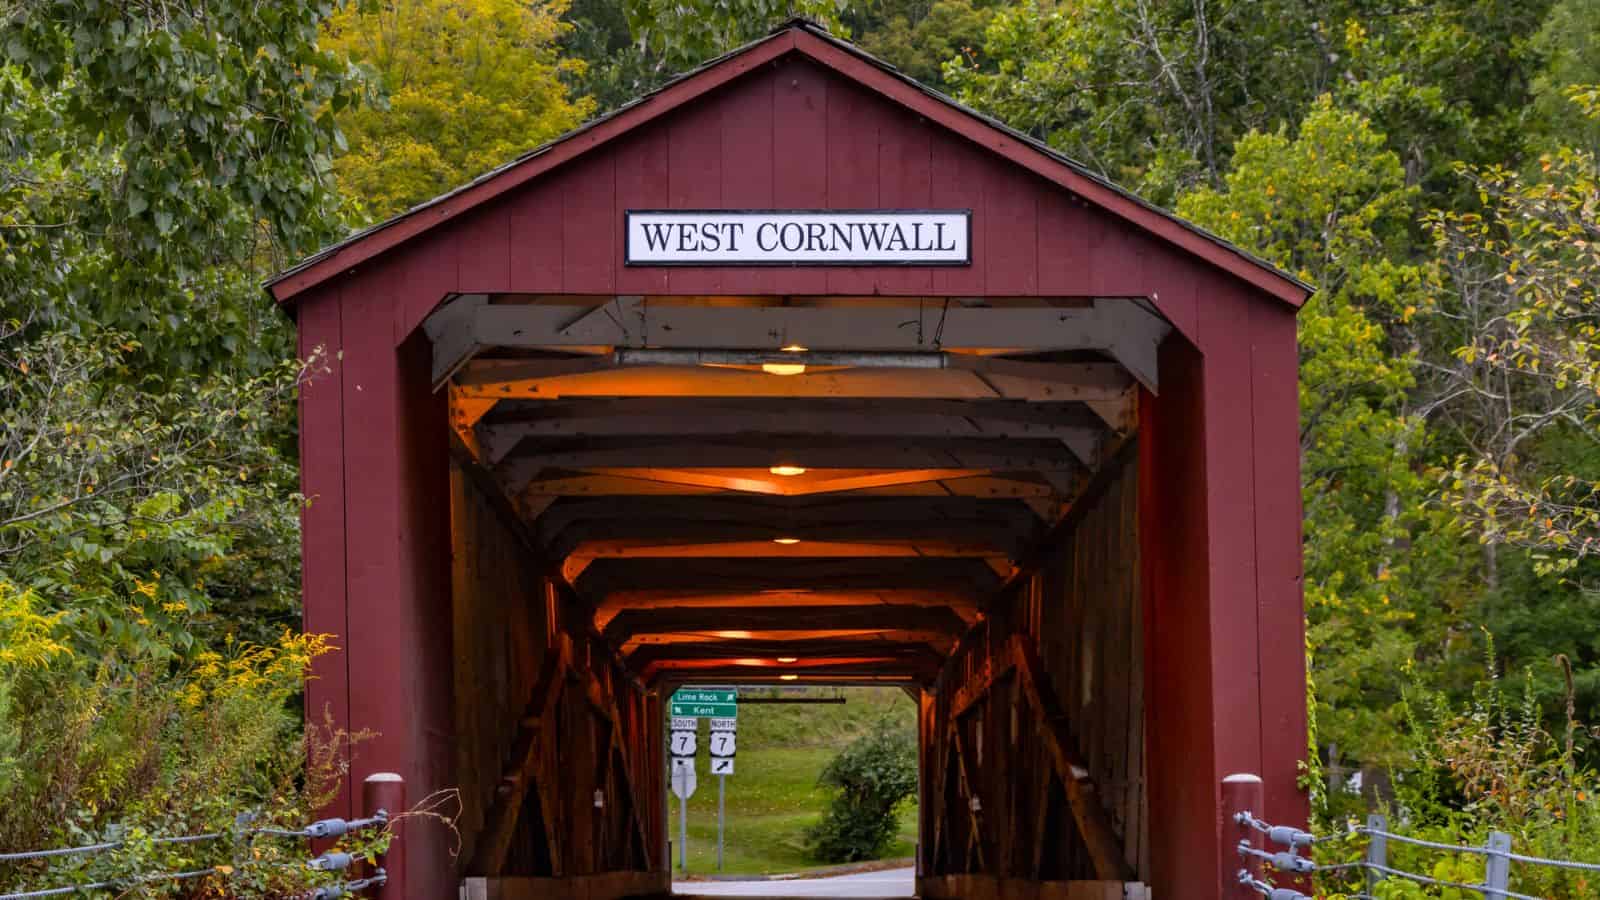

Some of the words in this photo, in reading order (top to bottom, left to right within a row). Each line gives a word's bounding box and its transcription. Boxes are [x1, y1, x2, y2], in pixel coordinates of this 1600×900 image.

[641, 222, 744, 252] WEST
[756, 222, 956, 252] CORNWALL
[677, 693, 697, 701] Lime
[699, 693, 718, 701] Rock
[694, 706, 714, 715] Kent
[672, 719, 697, 728] SOUTH
[711, 719, 736, 728] NORTH
[679, 736, 688, 751] 7
[719, 737, 728, 751] 7
